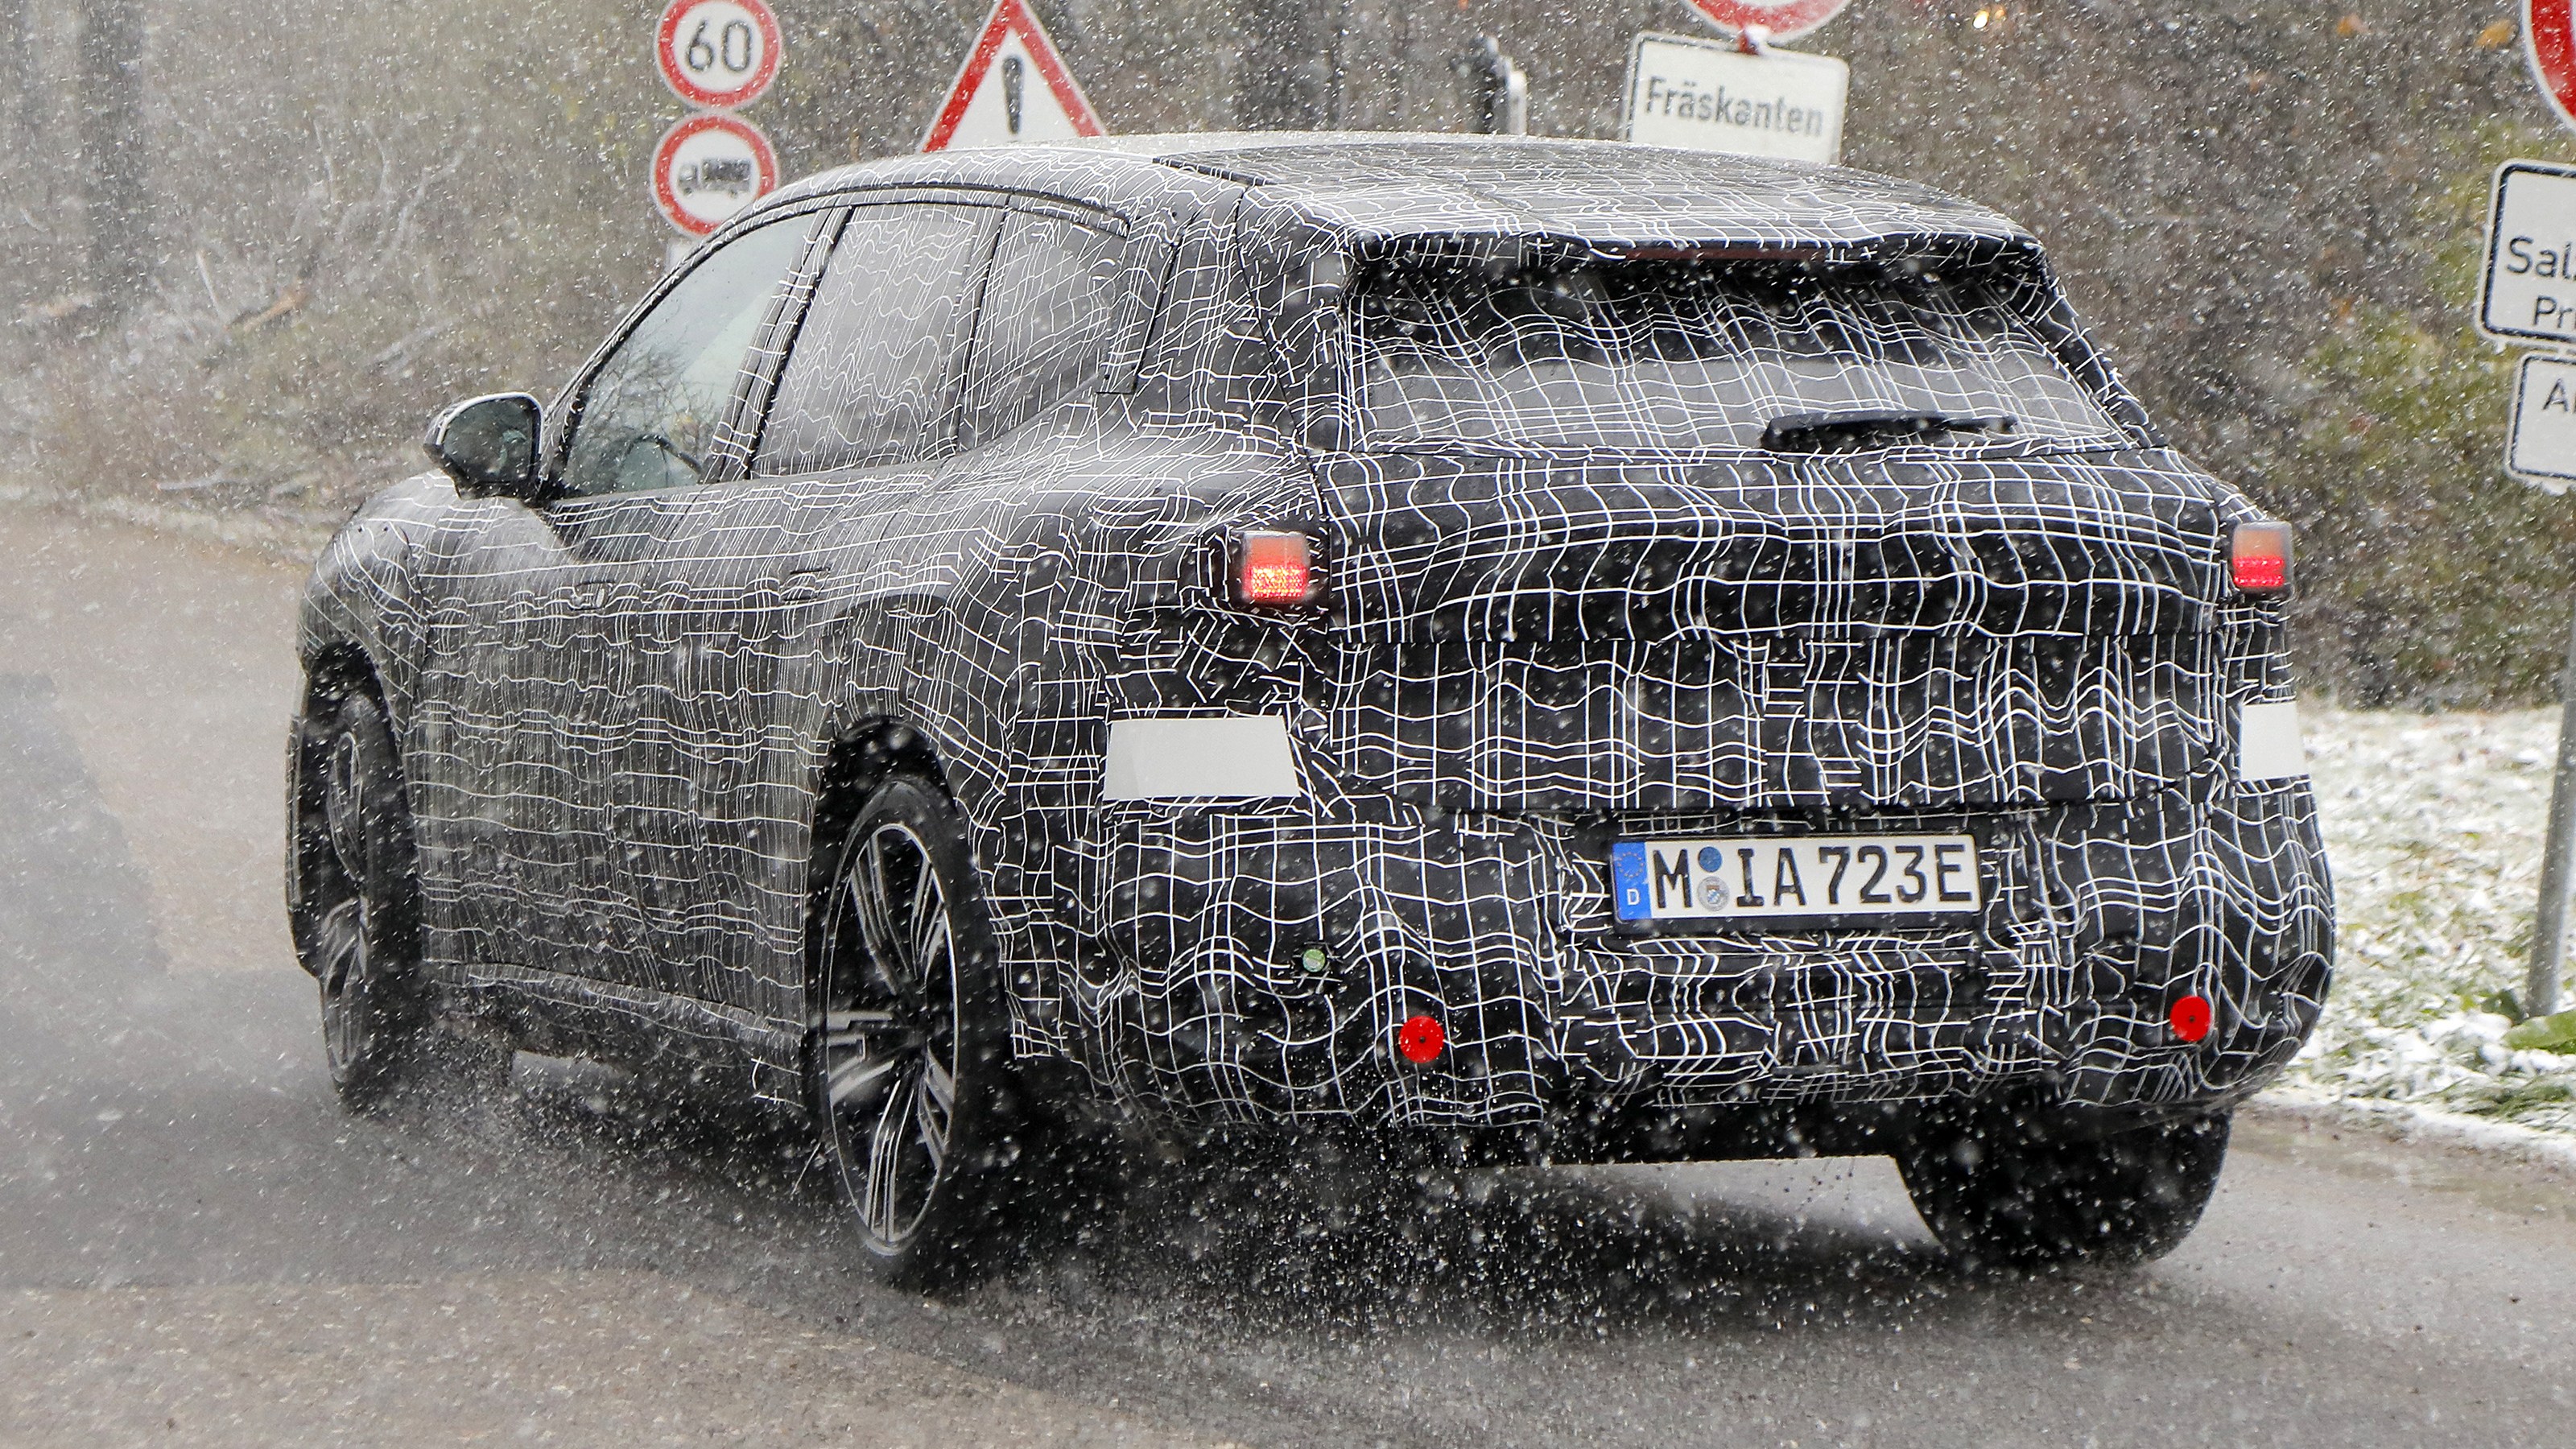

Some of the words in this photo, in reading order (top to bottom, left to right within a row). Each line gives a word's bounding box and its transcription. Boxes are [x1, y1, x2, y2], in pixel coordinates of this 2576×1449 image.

[687, 18, 752, 72] 60
[1645, 75, 1824, 137] Fräskanten
[2507, 236, 2576, 281] Sal
[2533, 295, 2576, 328] Pr
[2541, 378, 2576, 413] A
[1627, 889, 1640, 906] D
